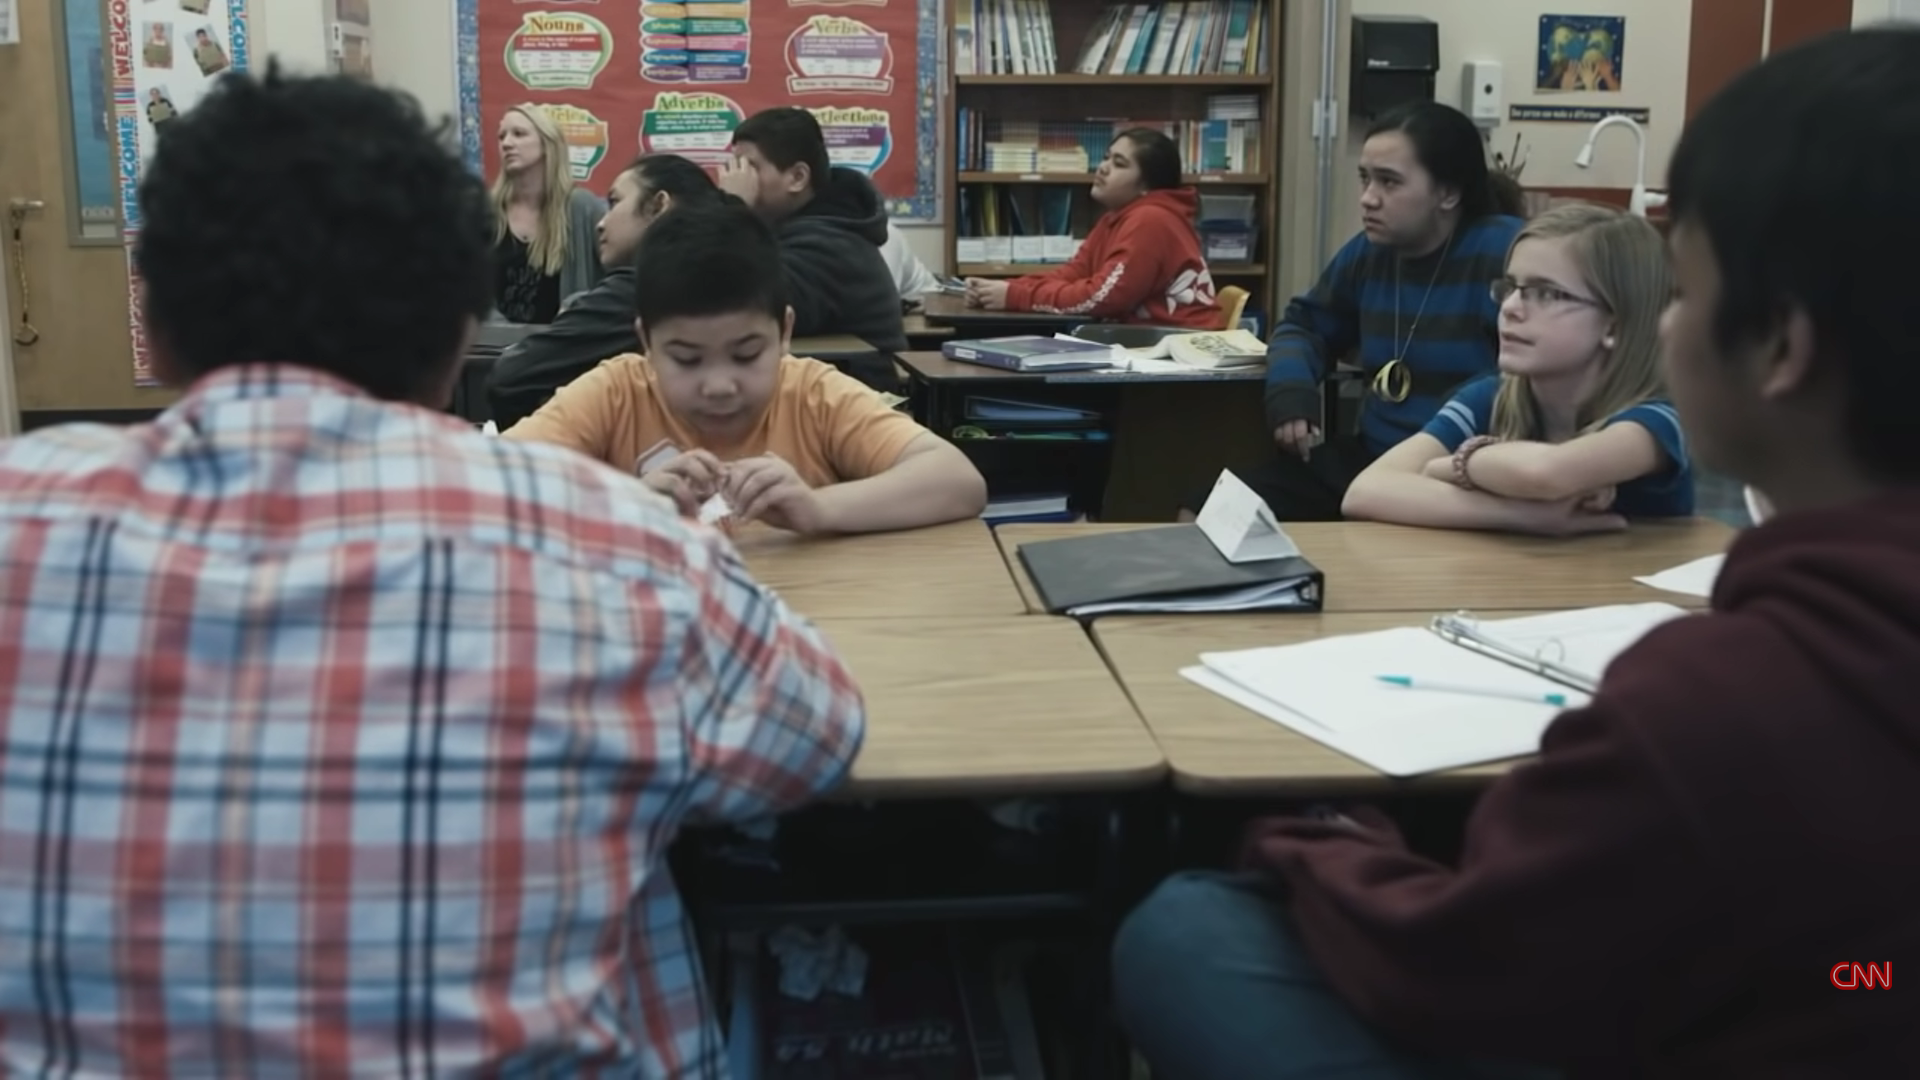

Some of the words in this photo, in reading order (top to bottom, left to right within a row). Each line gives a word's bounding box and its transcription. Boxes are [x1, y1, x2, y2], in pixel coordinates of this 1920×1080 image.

[529, 16, 585, 32] Nouns
[814, 19, 860, 34] Verbs
[112, 0, 130, 76] WELCO
[659, 96, 725, 110] Adverbs
[120, 116, 139, 221] WELCOME
